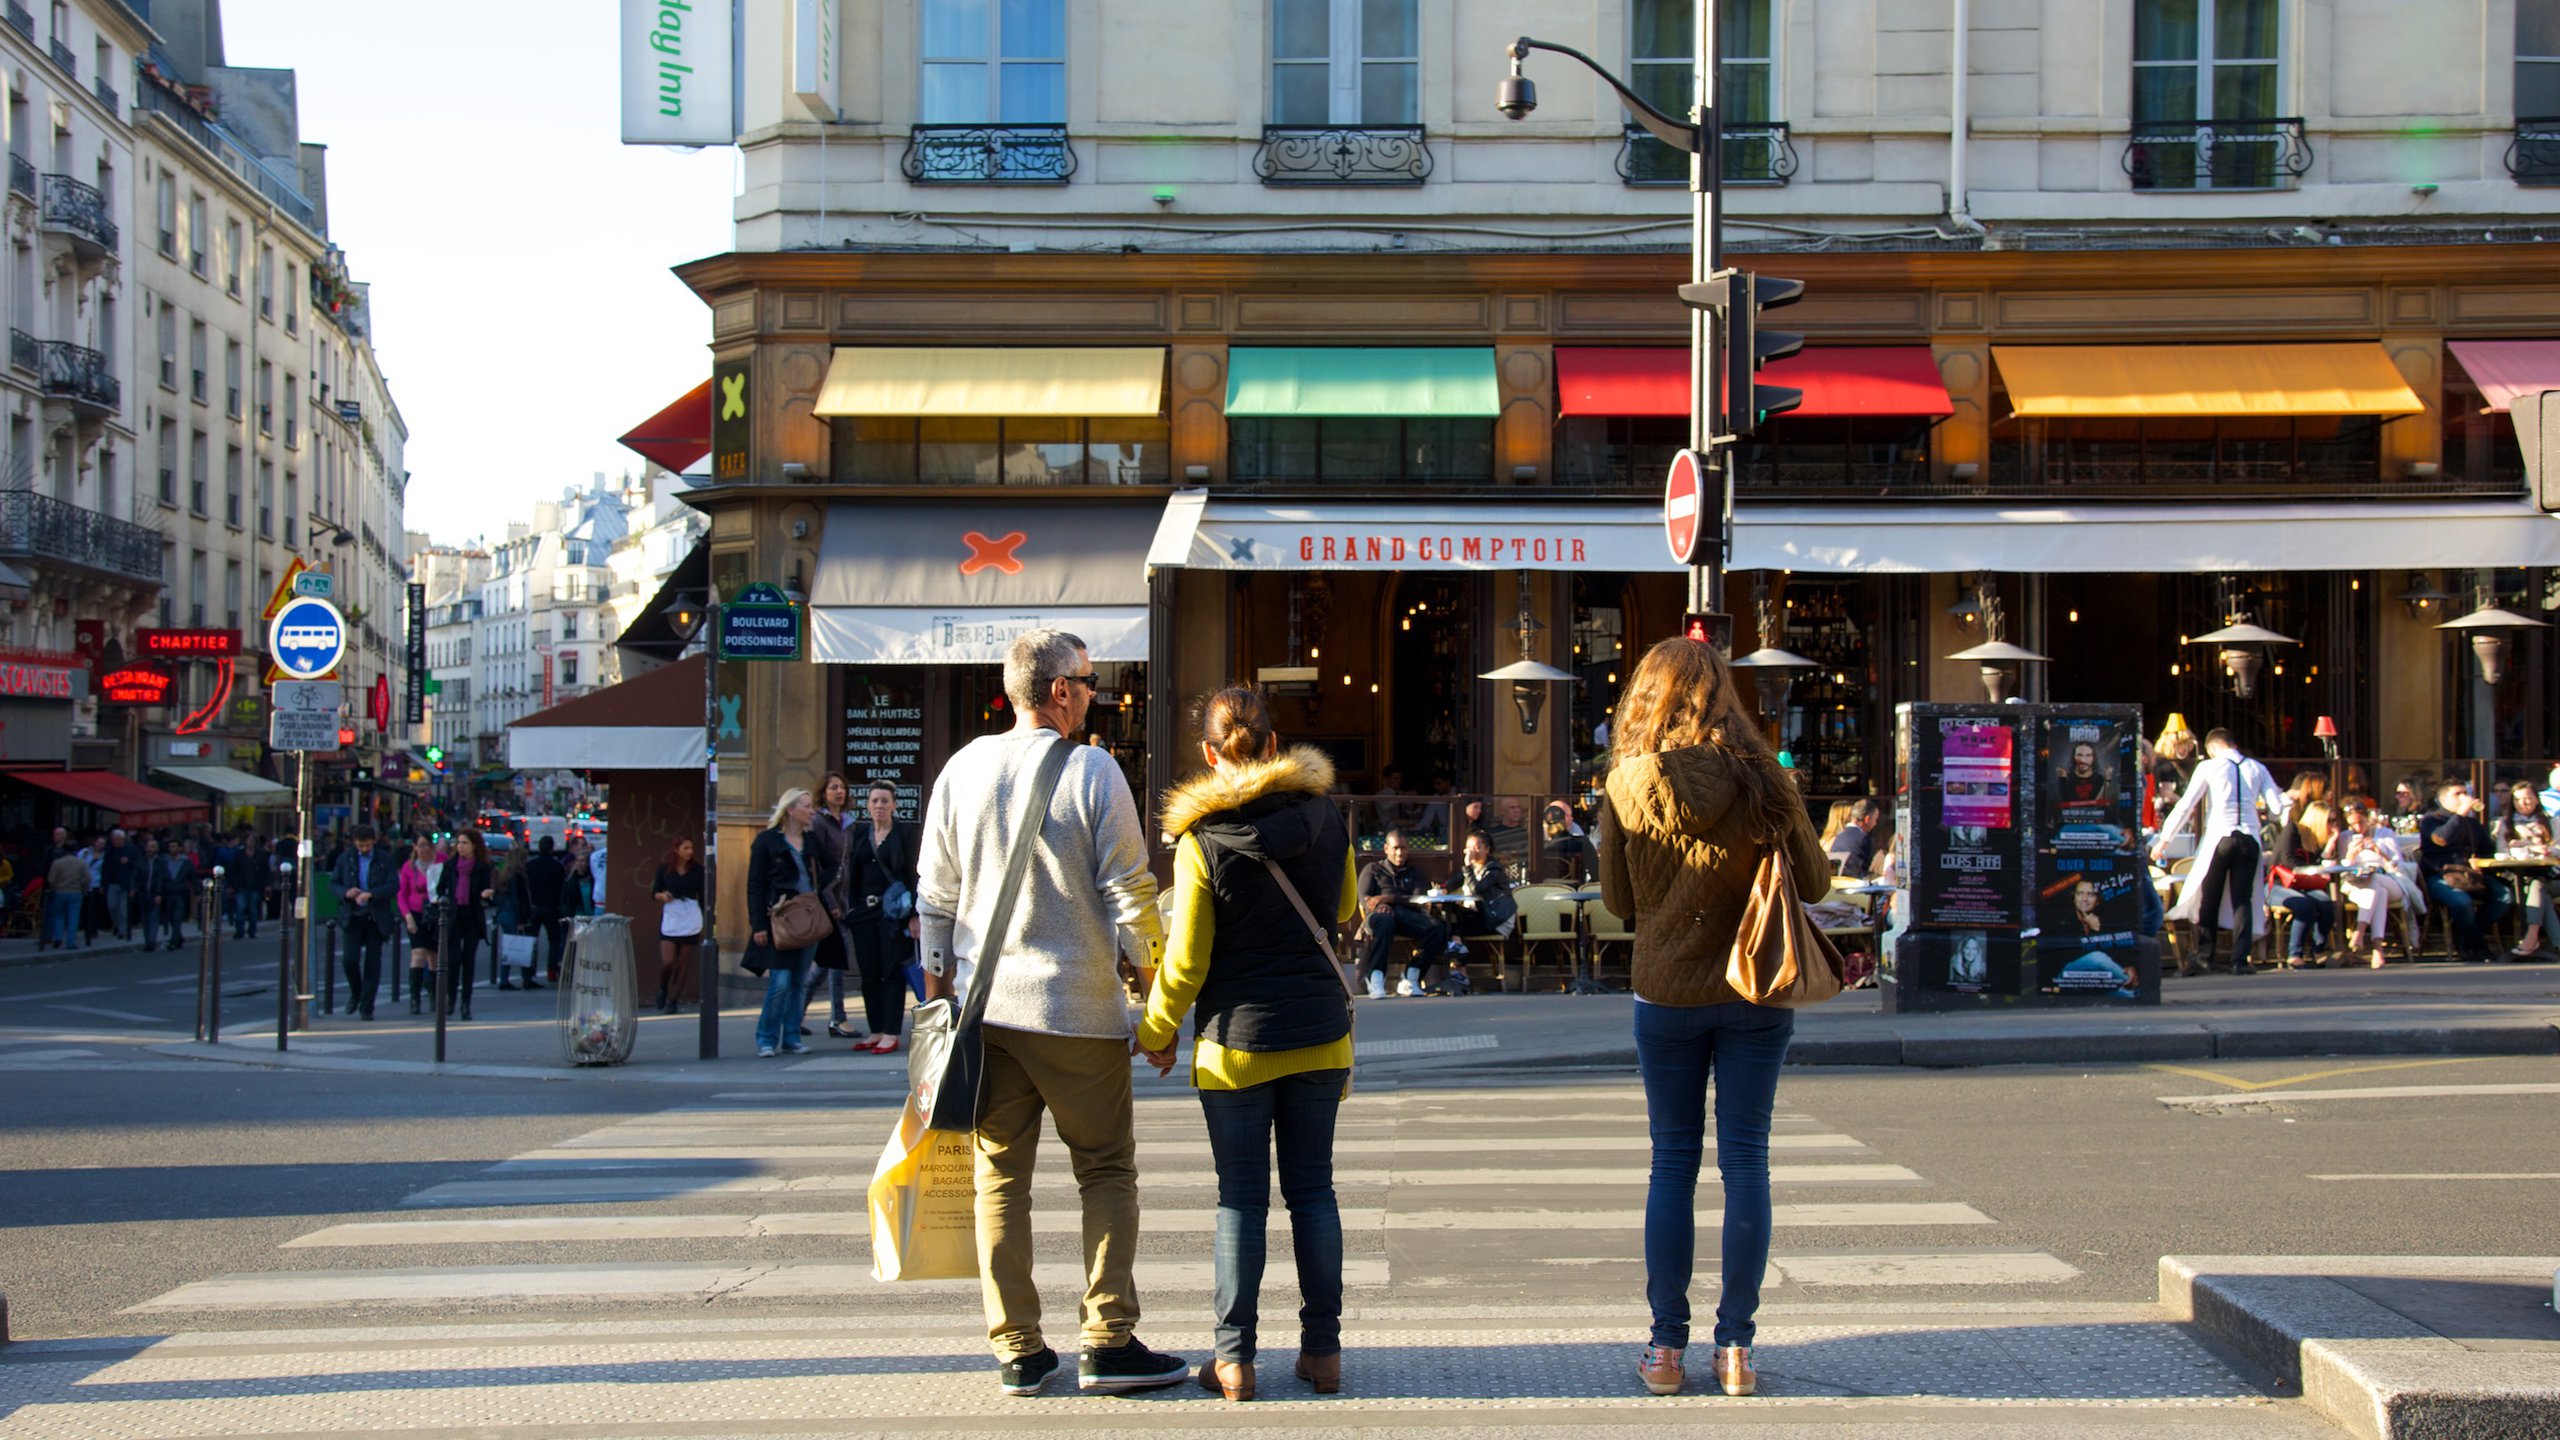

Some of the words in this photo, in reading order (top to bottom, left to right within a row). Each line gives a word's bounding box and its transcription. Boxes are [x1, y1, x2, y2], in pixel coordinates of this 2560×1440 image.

[659, 61, 693, 117] Inn
[1300, 536, 1405, 561] GRAND
[1419, 537, 1586, 561] COMPTOIR
[732, 617, 789, 628] BOULEVARD
[150, 636, 228, 649] CHARTIER
[725, 634, 796, 646] POISSONNIÈRE
[8, 666, 72, 697] CAVISTES
[102, 671, 170, 689] RESTAURANT
[111, 689, 161, 701] CHARTIER
[874, 695, 889, 706] LE
[847, 755, 868, 764] FINES
[869, 756, 878, 764] DE
[882, 755, 915, 764] CLAIRE
[866, 769, 901, 779] BELONS
[895, 800, 917, 808] ORTER
[938, 1145, 971, 1155] PARIS
[920, 1164, 975, 1172] MAROQUINE
[933, 1177, 973, 1185] BAGAGE
[924, 1189, 977, 1198] ACCESSOIR
